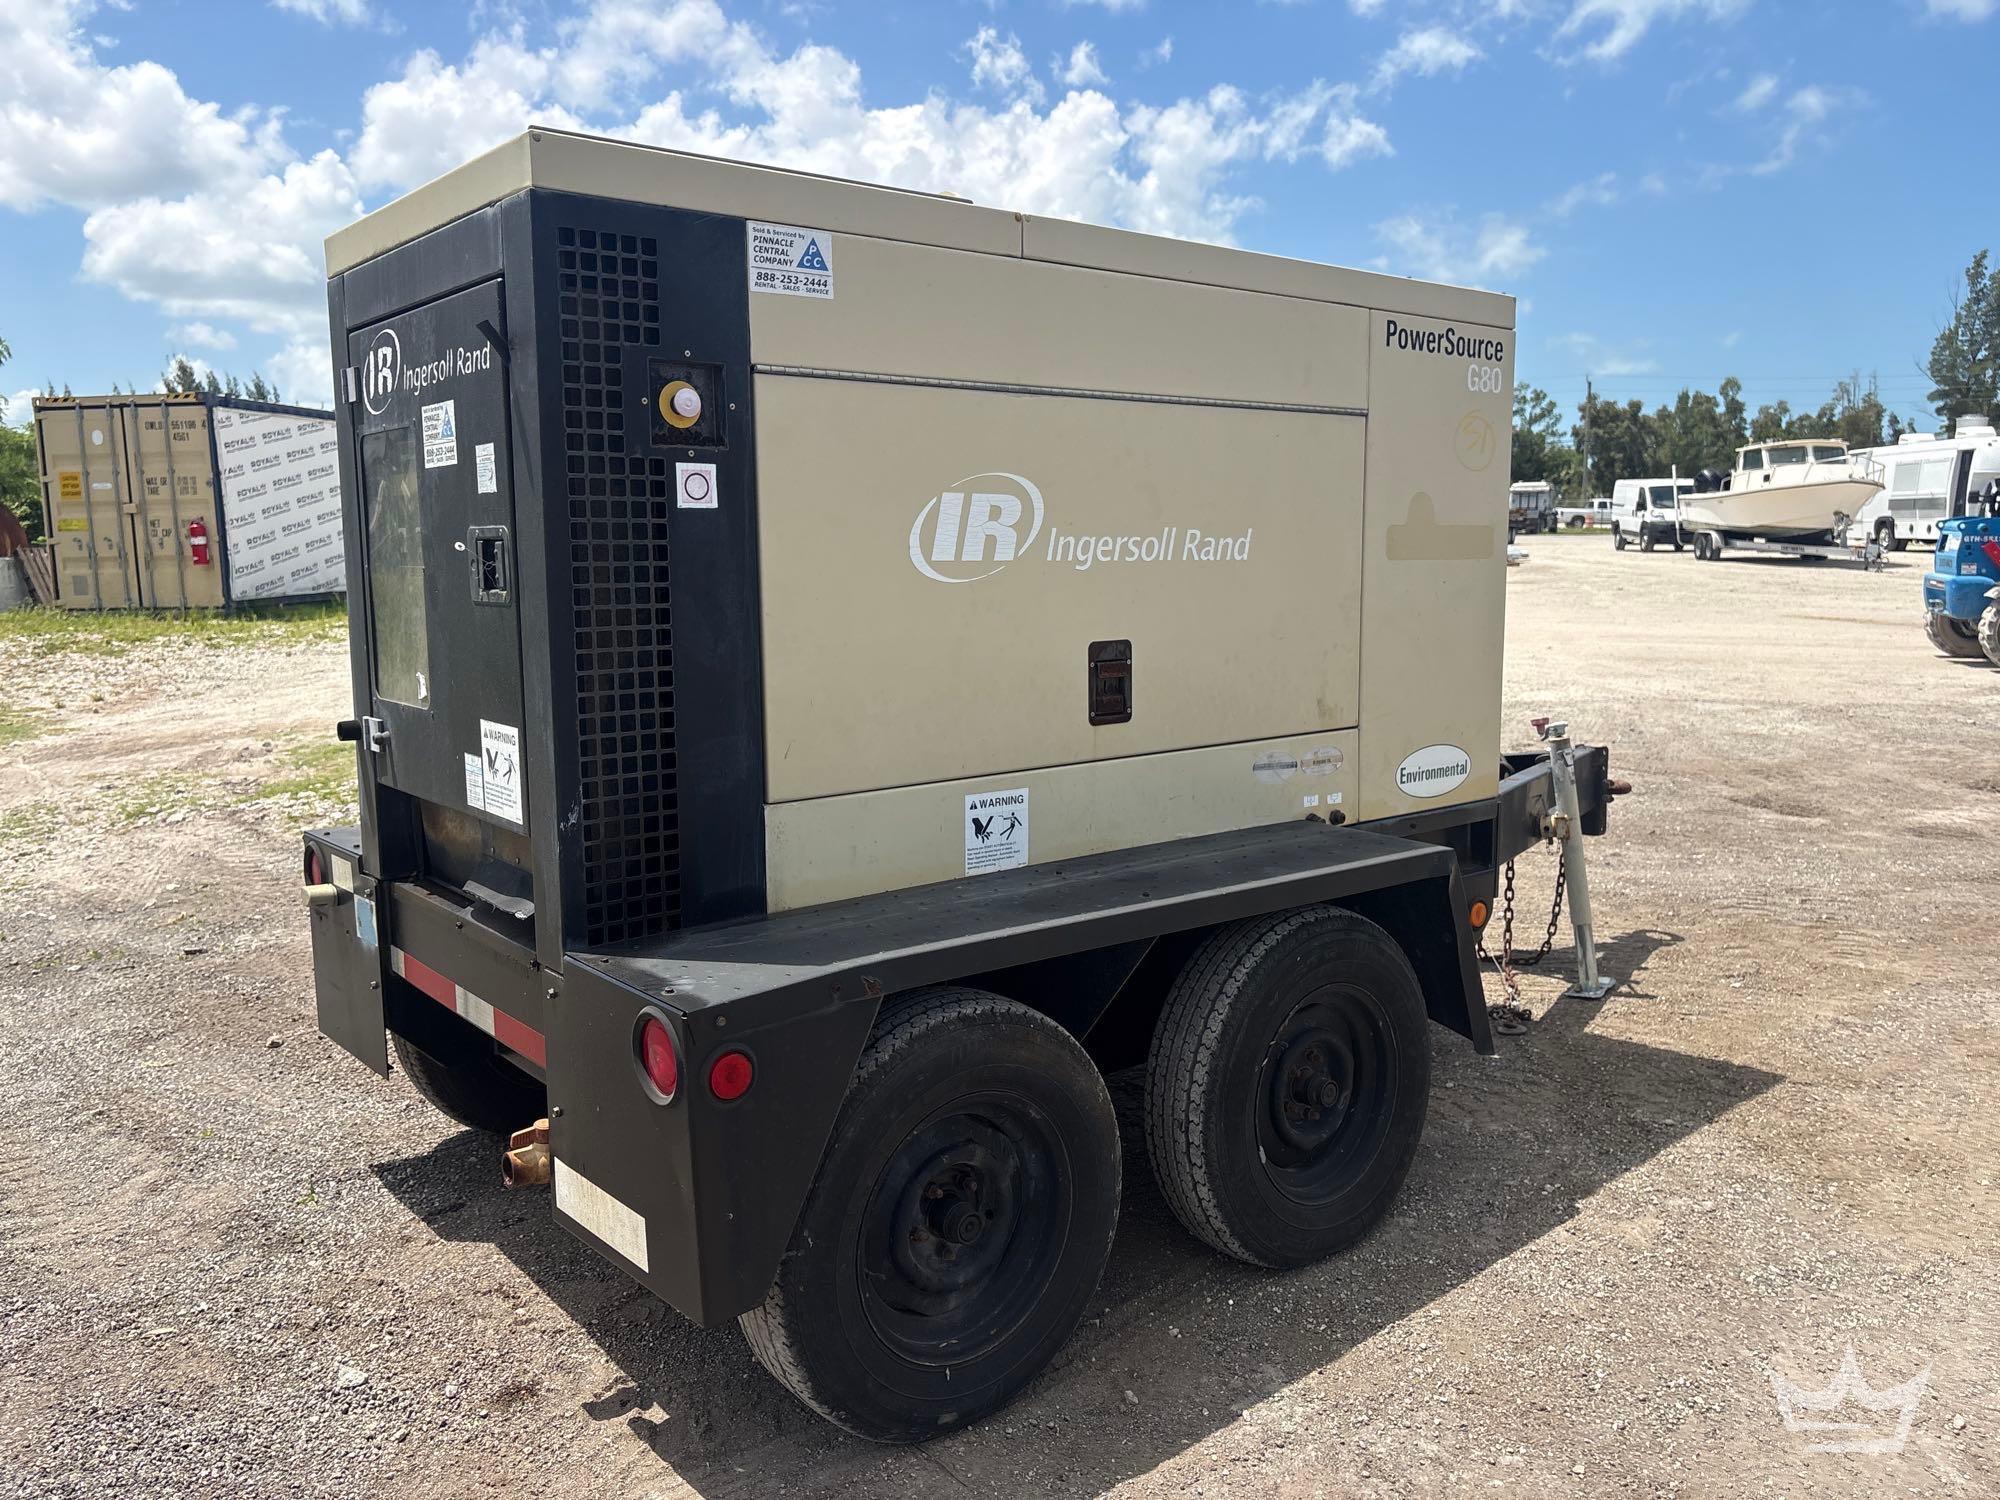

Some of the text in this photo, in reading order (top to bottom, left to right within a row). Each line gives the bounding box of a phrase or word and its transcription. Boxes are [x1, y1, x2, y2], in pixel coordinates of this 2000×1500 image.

[752, 226, 766, 234] Sold
[772, 230, 797, 239] Serviced
[753, 235, 795, 248] PINNACLE
[753, 245, 790, 257] CENTRAL
[753, 254, 794, 267] COMPANY
[756, 271, 828, 288] 888-253-2444
[754, 281, 777, 289] RENTAL
[782, 284, 800, 292] SALES
[805, 287, 829, 295] SERVICE
[1386, 319, 1504, 362] PowerSource
[369, 340, 490, 400] IR Ingersoll Rand
[1467, 364, 1502, 393] G80
[320, 441, 337, 450] ROYA
[931, 492, 1253, 571] IR Ingersoll Rand
[489, 730, 516, 746] WARNING
[1400, 759, 1468, 785] Environmental
[979, 794, 1024, 809] WARNING
